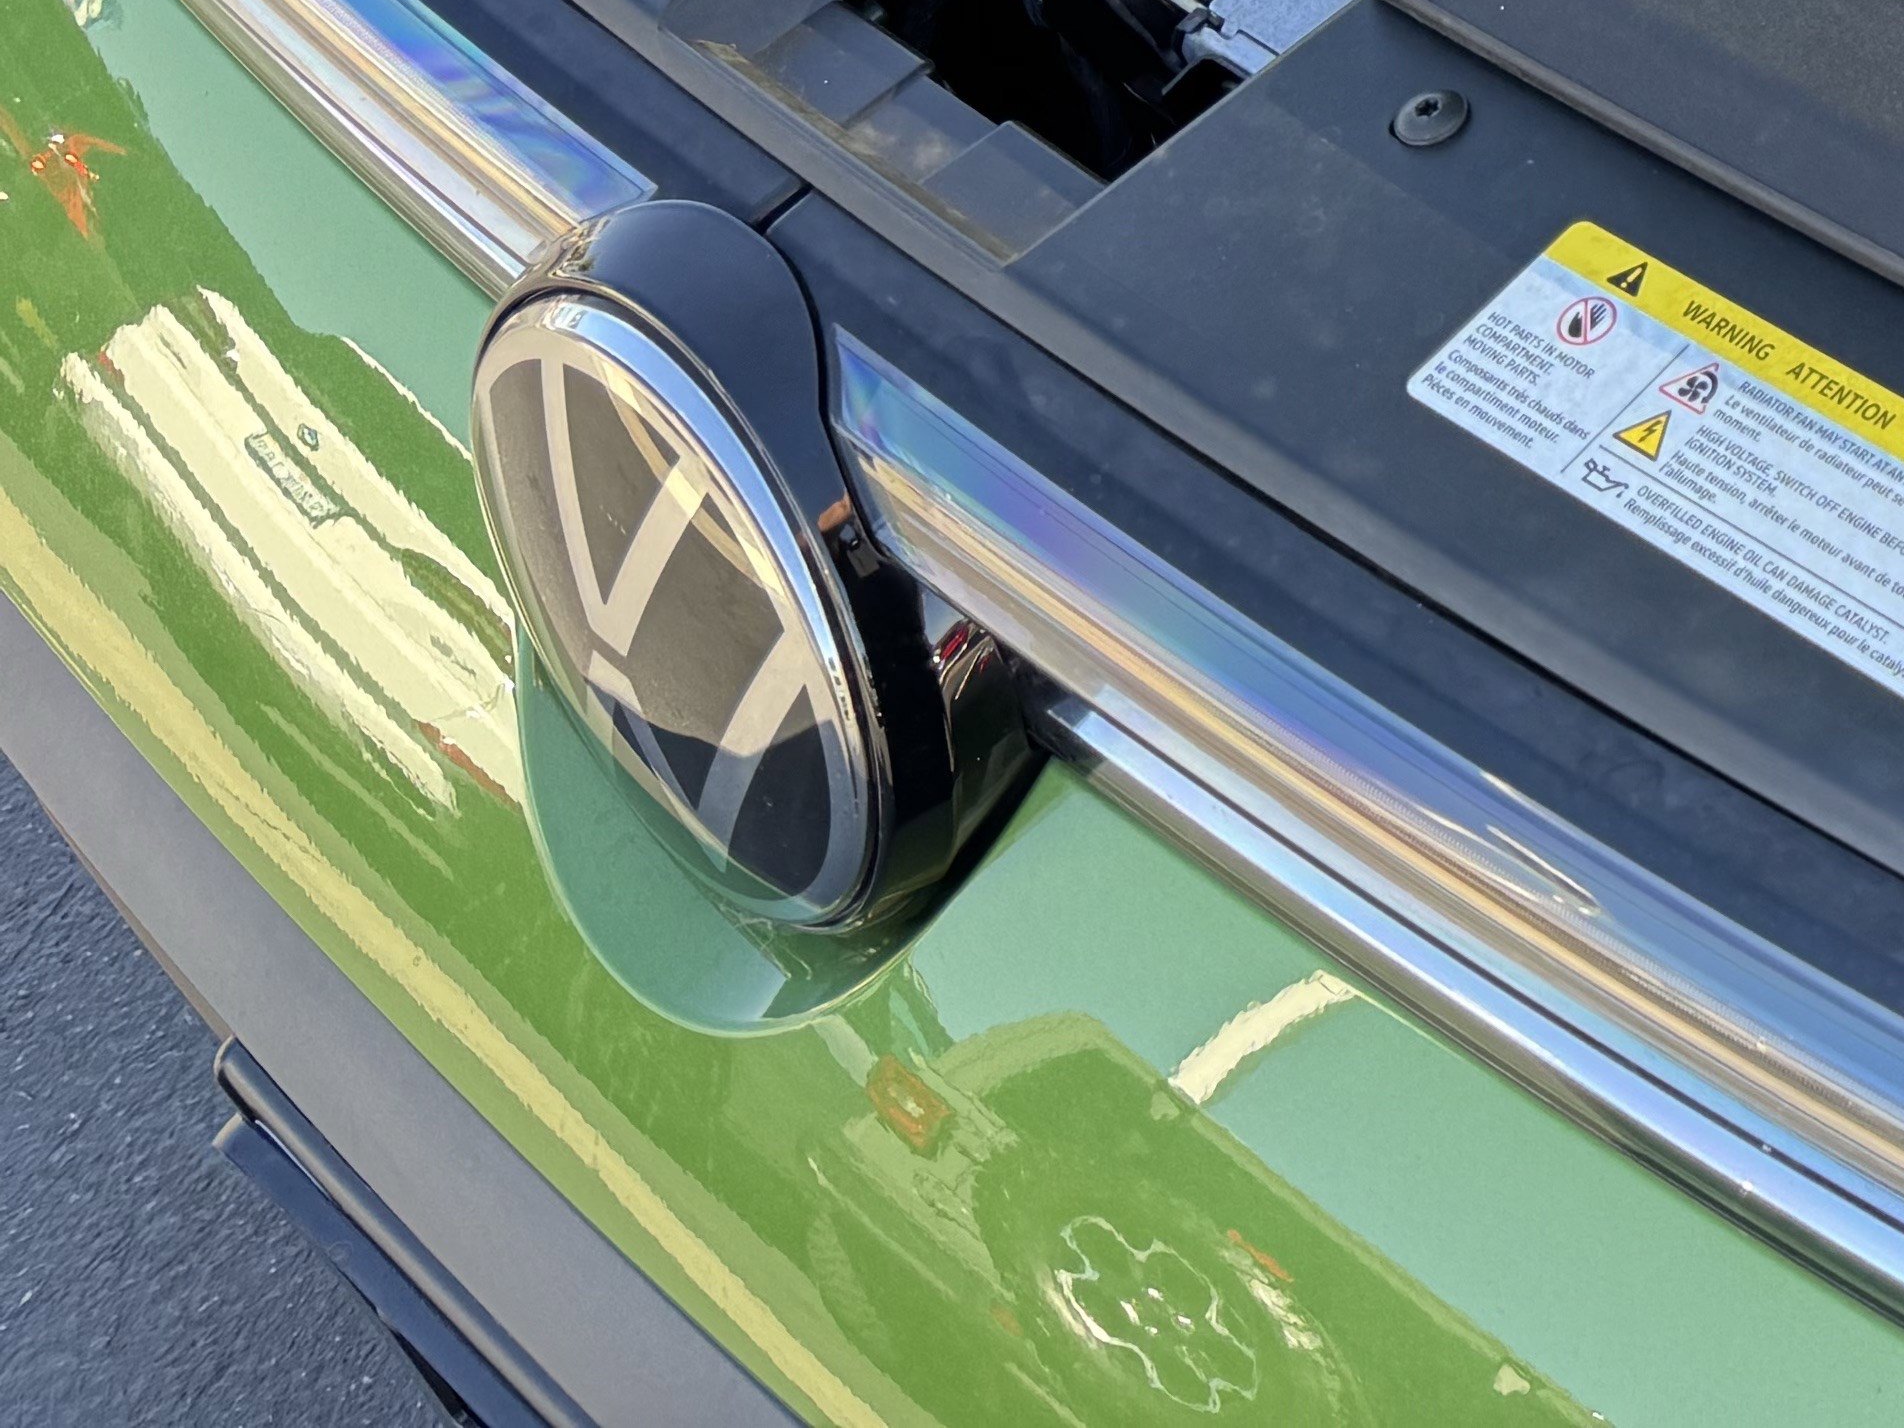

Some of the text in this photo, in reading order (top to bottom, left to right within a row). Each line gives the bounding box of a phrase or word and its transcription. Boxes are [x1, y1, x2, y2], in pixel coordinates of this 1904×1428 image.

[1462, 333, 1541, 387] MOVING PARTS.
[1475, 323, 1554, 375] COMPARTMENT.
[1486, 310, 1595, 379] HOT PARTS IN MOTOR
[1682, 300, 1896, 430] WARNING ATTENTION
[1420, 372, 1534, 449] Pièces en mouvement.
[1433, 360, 1560, 444] le compartiment moteur.
[1446, 348, 1510, 392] Composants
[1526, 398, 1566, 426] chauds
[1561, 419, 1591, 441] dans
[1712, 408, 1762, 443] moment.
[1736, 380, 1795, 418] RADIATOR
[1790, 411, 1818, 432] FAN
[1813, 424, 1843, 445] MAY
[1837, 437, 1876, 465] START
[1870, 457, 1891, 473] AT
[1657, 460, 1717, 504] l'allumage.
[1683, 436, 1778, 498] IGNITION SYSTEM.
[1694, 424, 1728, 448] HIGH
[1723, 439, 1774, 478] VOLTAGE,
[1772, 469, 1818, 501] SWITCH
[1814, 494, 1842, 513] OFF
[1836, 506, 1883, 539] ENGINE
[1723, 394, 1741, 410] Le
[1739, 404, 1800, 443] ventilateur
[1797, 437, 1816, 453] de
[1813, 448, 1866, 482] radiateur
[1860, 476, 1894, 499] peut
[1669, 449, 1706, 477] Haute
[1703, 470, 1747, 505] tension,
[1747, 497, 1789, 526] arrêter
[1785, 517, 1801, 534] le
[1798, 527, 1843, 558] moteur
[1840, 552, 1876, 579] avant
[1873, 571, 1892, 588] de
[1622, 497, 1692, 545] Remplissage
[1689, 540, 1738, 572] excessif
[1732, 565, 1773, 595] d'huile
[1770, 588, 1832, 630] dangereux
[1826, 624, 1860, 646] pour
[1855, 638, 1871, 655] le
[1636, 484, 1890, 645] OVERFILLED ENGINE OIL CAN DAMAGE CATALYST.
